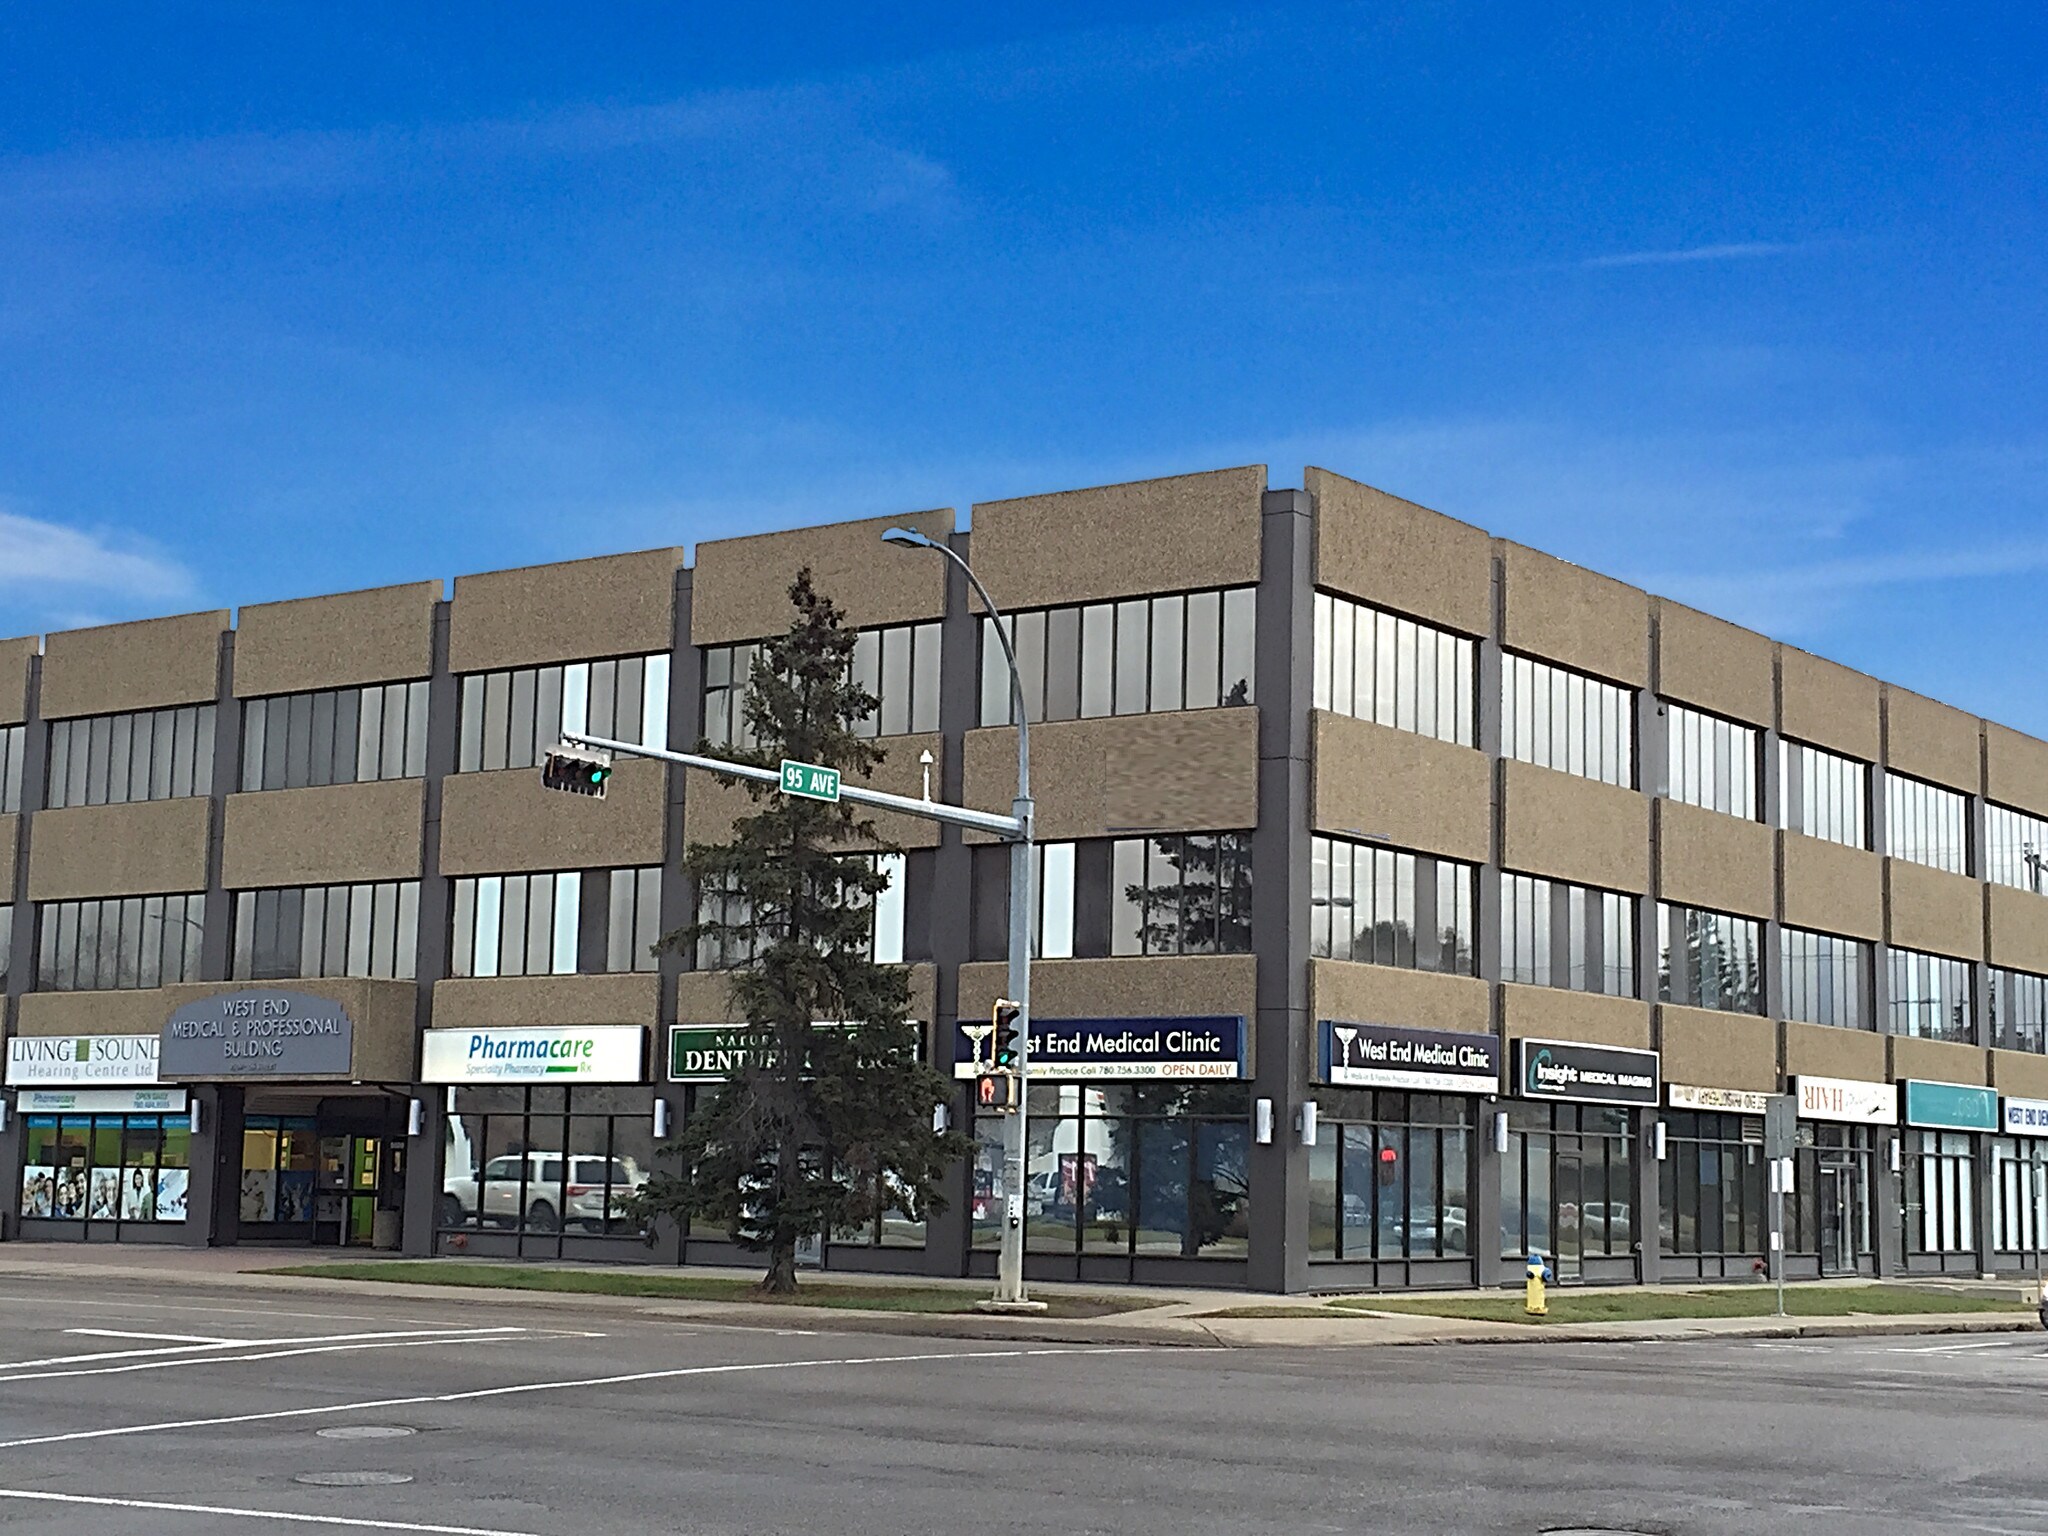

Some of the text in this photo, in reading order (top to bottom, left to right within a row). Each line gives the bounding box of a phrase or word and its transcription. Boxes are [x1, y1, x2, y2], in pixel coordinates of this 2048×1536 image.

[786, 767, 835, 795] 95 AVE
[223, 998, 291, 1017] WEST END
[171, 1018, 340, 1038] MEDICAL & PROFESSIONAL
[13, 1038, 159, 1061] LIVING SOUND
[224, 1039, 283, 1058] BUILDING
[469, 1034, 594, 1059] Pharmacare
[1026, 1029, 1221, 1054] st End Medical Clinic
[1358, 1038, 1490, 1069] West End Medical Clinic
[28, 1063, 154, 1080] Hearing Centre Ltd.
[503, 1062, 546, 1076] Pharmacy
[1027, 1067, 1047, 1076] amily
[1049, 1066, 1078, 1076] Practice
[1080, 1066, 1096, 1075] Call
[1162, 1064, 1195, 1076] OPEN
[1199, 1063, 1232, 1075] DAILY
[1537, 1062, 1652, 1088] Insight MEDICAL IMAGING
[1804, 1085, 1843, 1112] HAIR
[2008, 1106, 2024, 1124] WEST
